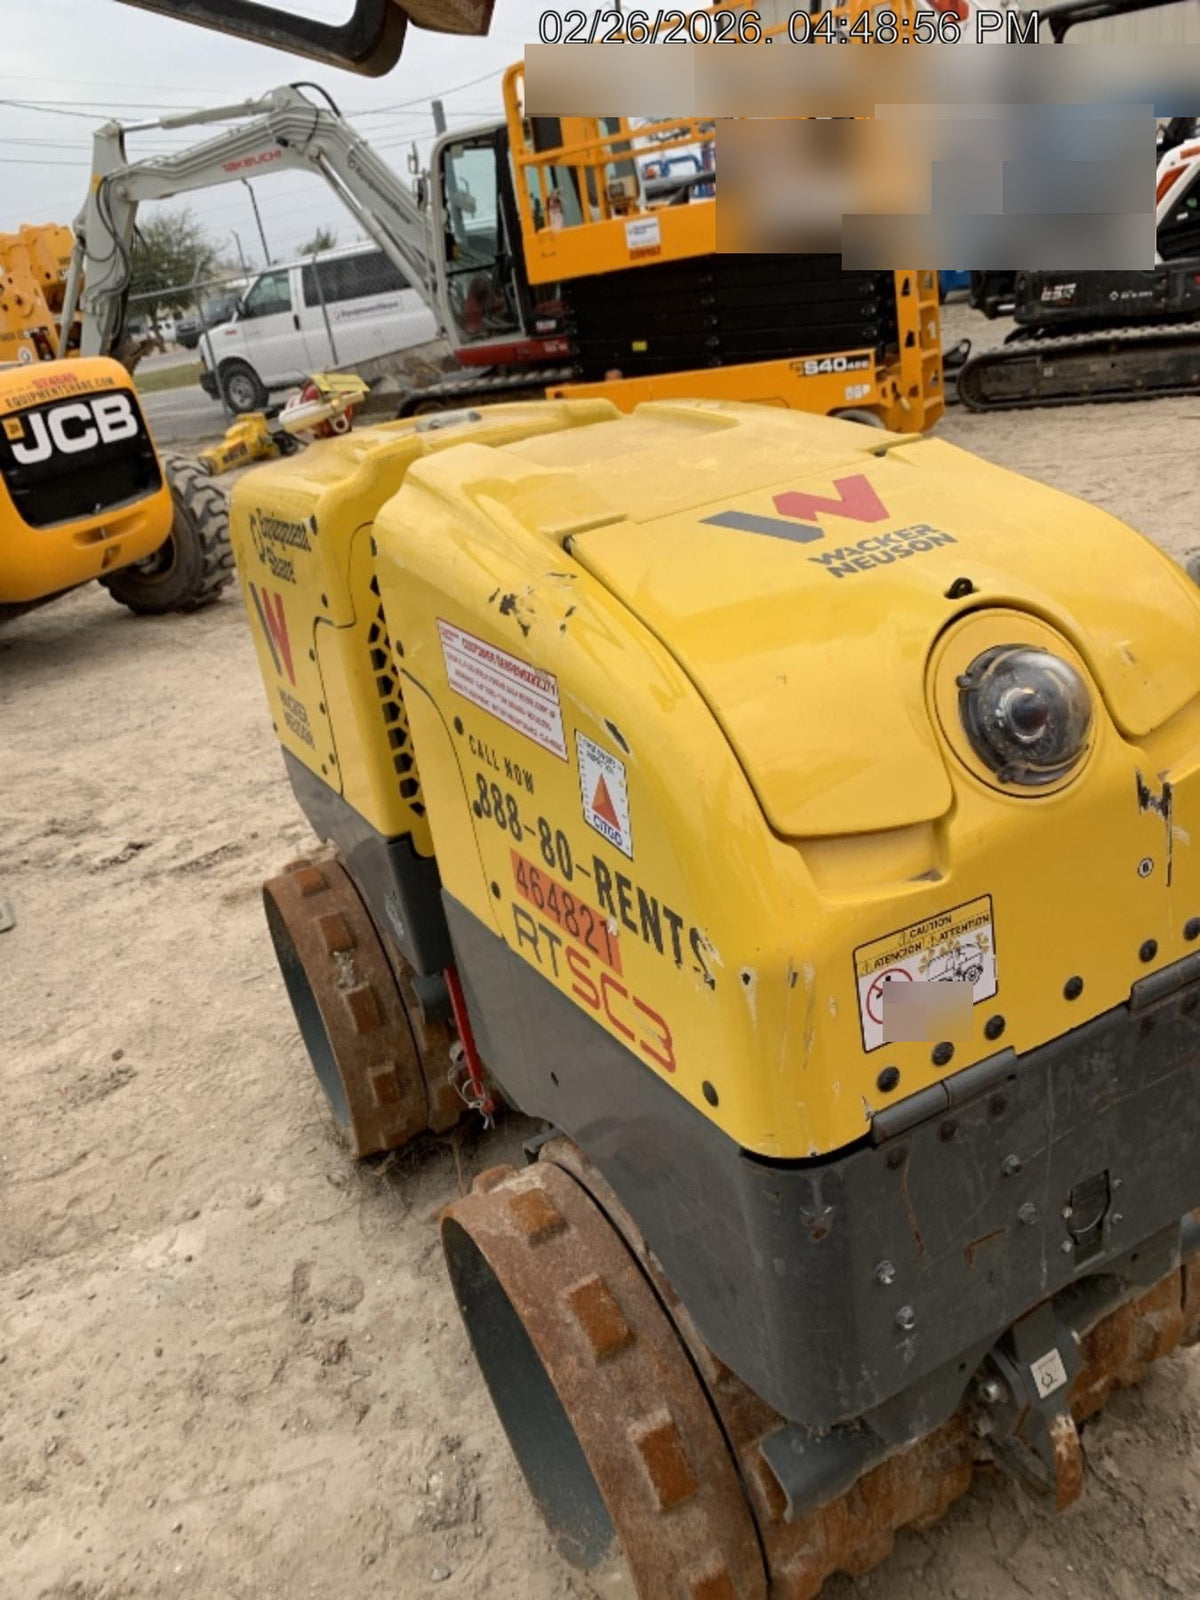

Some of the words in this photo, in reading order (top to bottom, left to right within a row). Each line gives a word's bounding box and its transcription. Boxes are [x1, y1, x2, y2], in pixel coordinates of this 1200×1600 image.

[10, 393, 139, 465] JCB
[806, 523, 941, 567] WACKER
[825, 532, 960, 579] NEUSON
[468, 733, 500, 772] CALL
[503, 761, 535, 795] NOW
[592, 814, 624, 848] CITGO
[515, 857, 615, 967] 464821
[909, 914, 952, 939] CAUTION
[939, 912, 990, 941] ATTENTION
